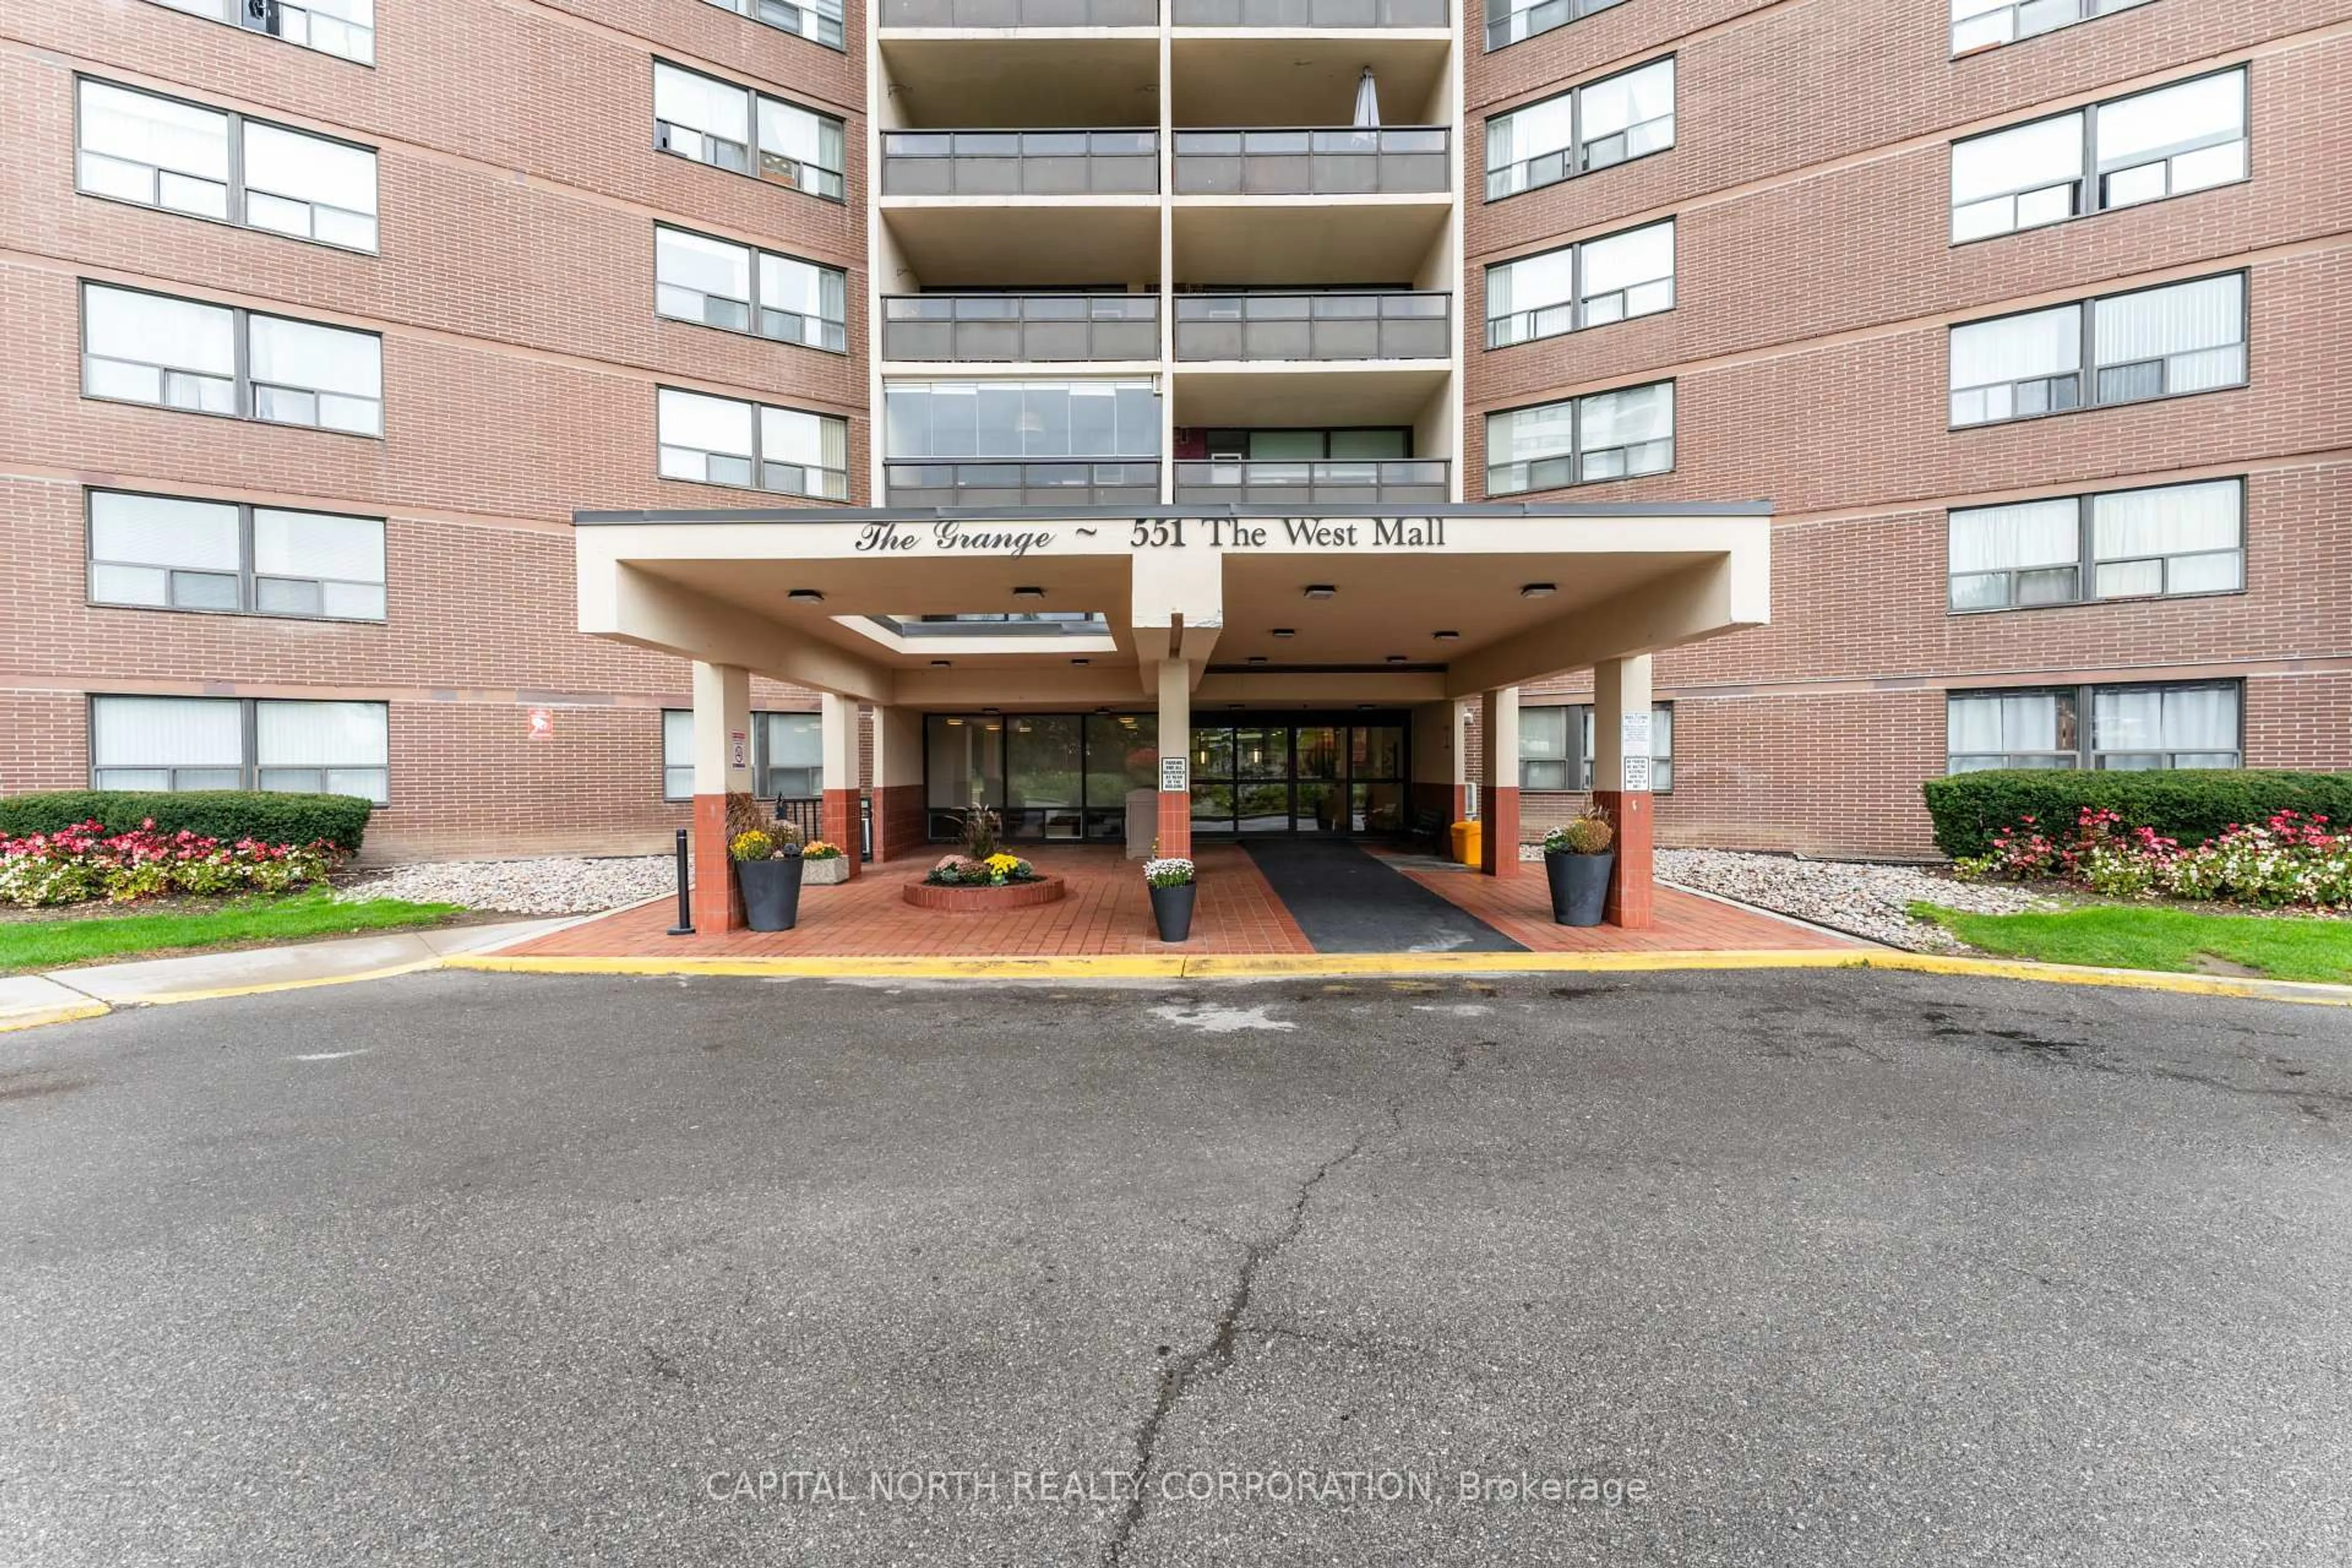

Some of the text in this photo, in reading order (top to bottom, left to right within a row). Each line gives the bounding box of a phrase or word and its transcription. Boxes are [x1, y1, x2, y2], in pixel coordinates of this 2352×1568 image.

[855, 521, 921, 551] The
[933, 521, 1057, 560] Grange
[1130, 518, 1186, 547] 551
[1202, 518, 1267, 547] The
[1284, 518, 1359, 546] West
[1372, 518, 1446, 546] Mall
